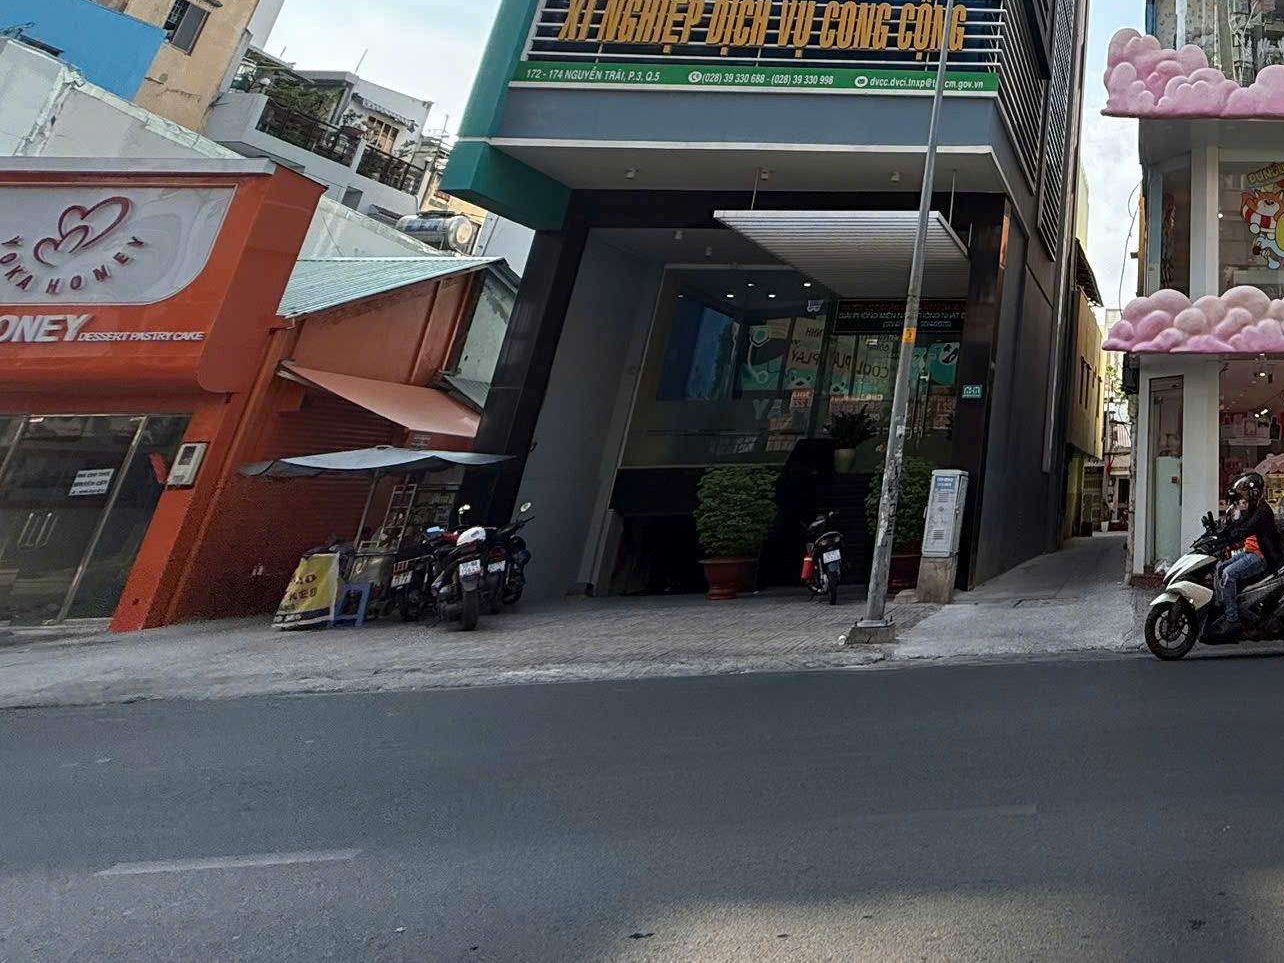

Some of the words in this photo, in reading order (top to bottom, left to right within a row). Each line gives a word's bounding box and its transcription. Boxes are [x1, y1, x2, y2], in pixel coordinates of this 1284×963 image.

[777, 0, 817, 59] VỤ
[526, 69, 542, 80] 172
[549, 69, 564, 80] 174
[701, 72, 722, 84] (028)
[723, 72, 735, 84] 39
[735, 73, 750, 84] 330
[771, 74, 791, 86] (028)
[792, 74, 803, 85] 39
[803, 75, 818, 85] 330
[819, 75, 834, 85] 998
[46, 236, 145, 294] HONEY
[78, 331, 130, 341] DESSERT
[130, 331, 173, 341] PASTRY
[173, 331, 206, 341] CAKE
